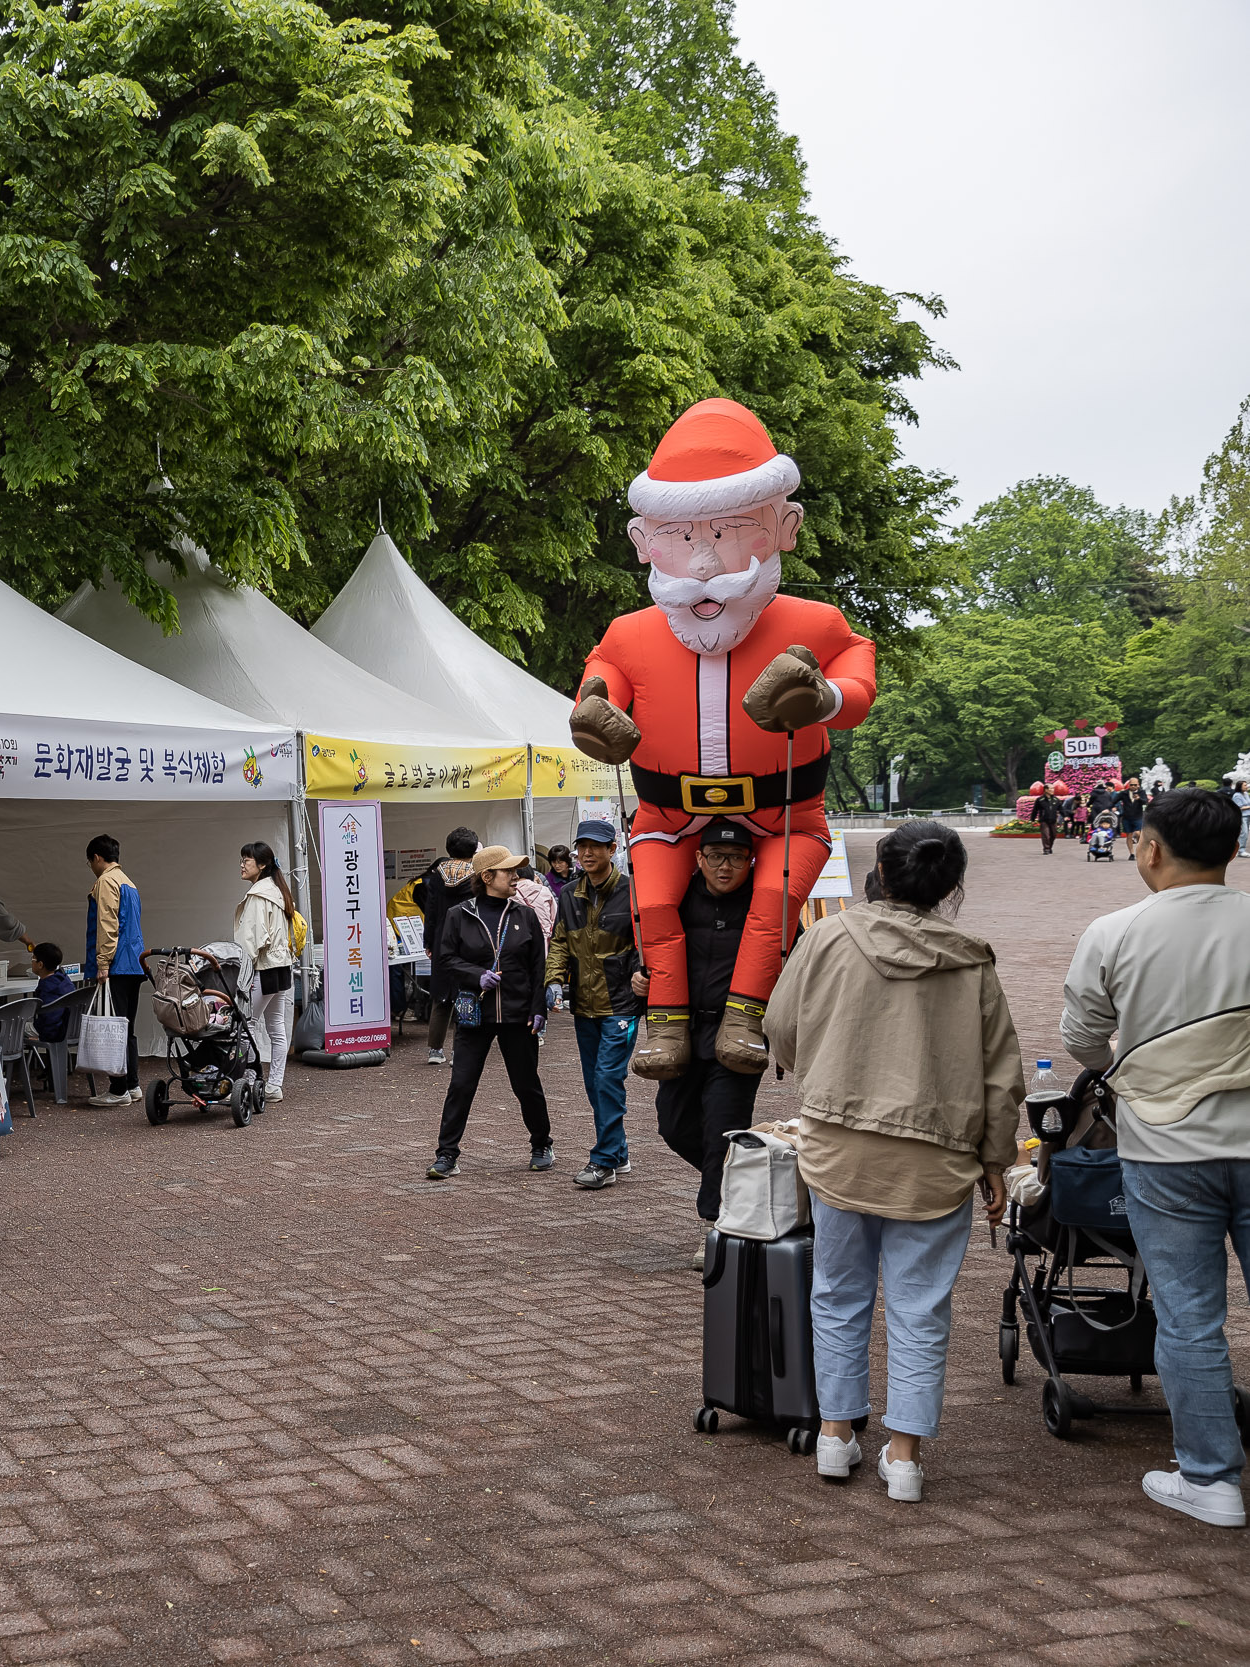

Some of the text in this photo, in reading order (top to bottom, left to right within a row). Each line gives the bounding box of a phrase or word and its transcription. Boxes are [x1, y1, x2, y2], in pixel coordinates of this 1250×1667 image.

[1067, 740, 1098, 753] 50th
[33, 743, 226, 785] 문화재발굴 및 복식체험
[384, 762, 473, 789] 글로벌놀이체험
[342, 821, 357, 834] 가족
[342, 833, 358, 845] 센터
